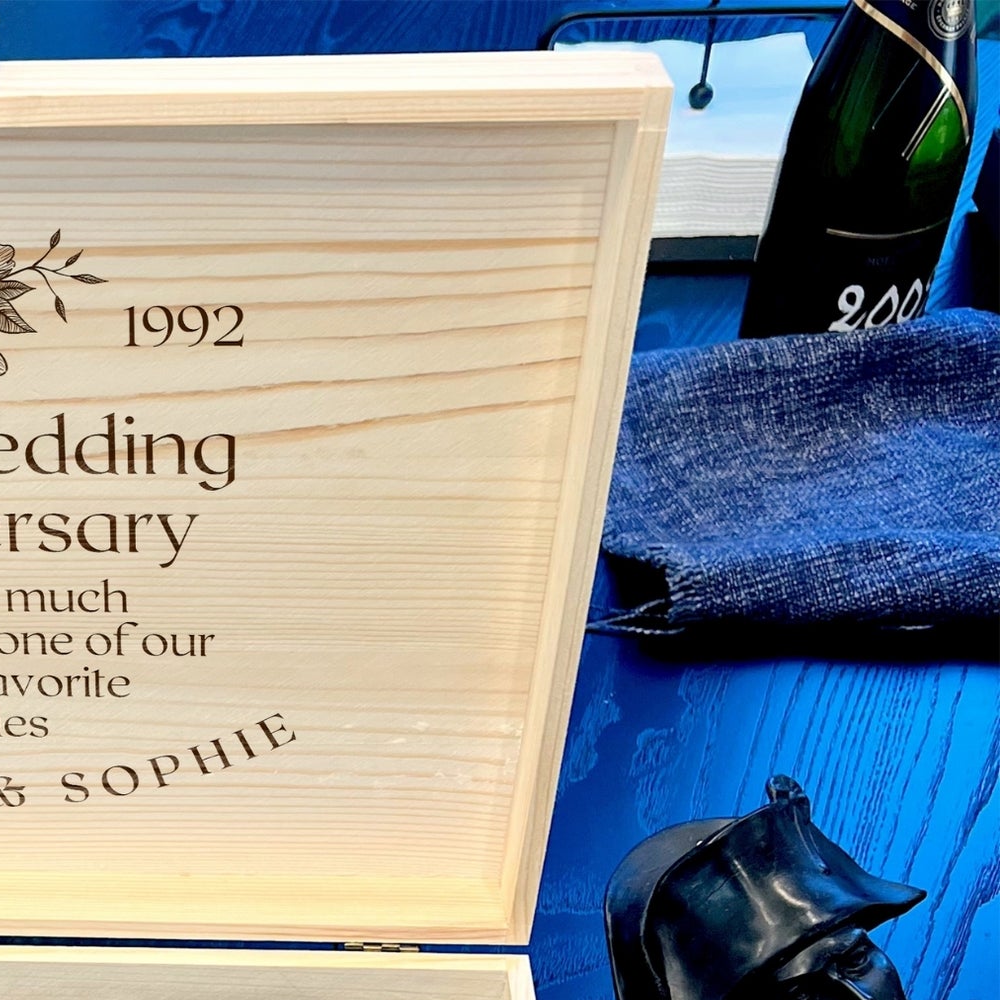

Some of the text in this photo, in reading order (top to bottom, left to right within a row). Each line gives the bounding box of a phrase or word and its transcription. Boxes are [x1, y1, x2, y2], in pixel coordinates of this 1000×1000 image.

[123, 304, 245, 348] 1992
[828, 278, 931, 331] 200
[5, 578, 129, 613] much
[85, 621, 139, 656] of
[141, 632, 216, 657] our
[60, 712, 297, 804] SOPHIE
